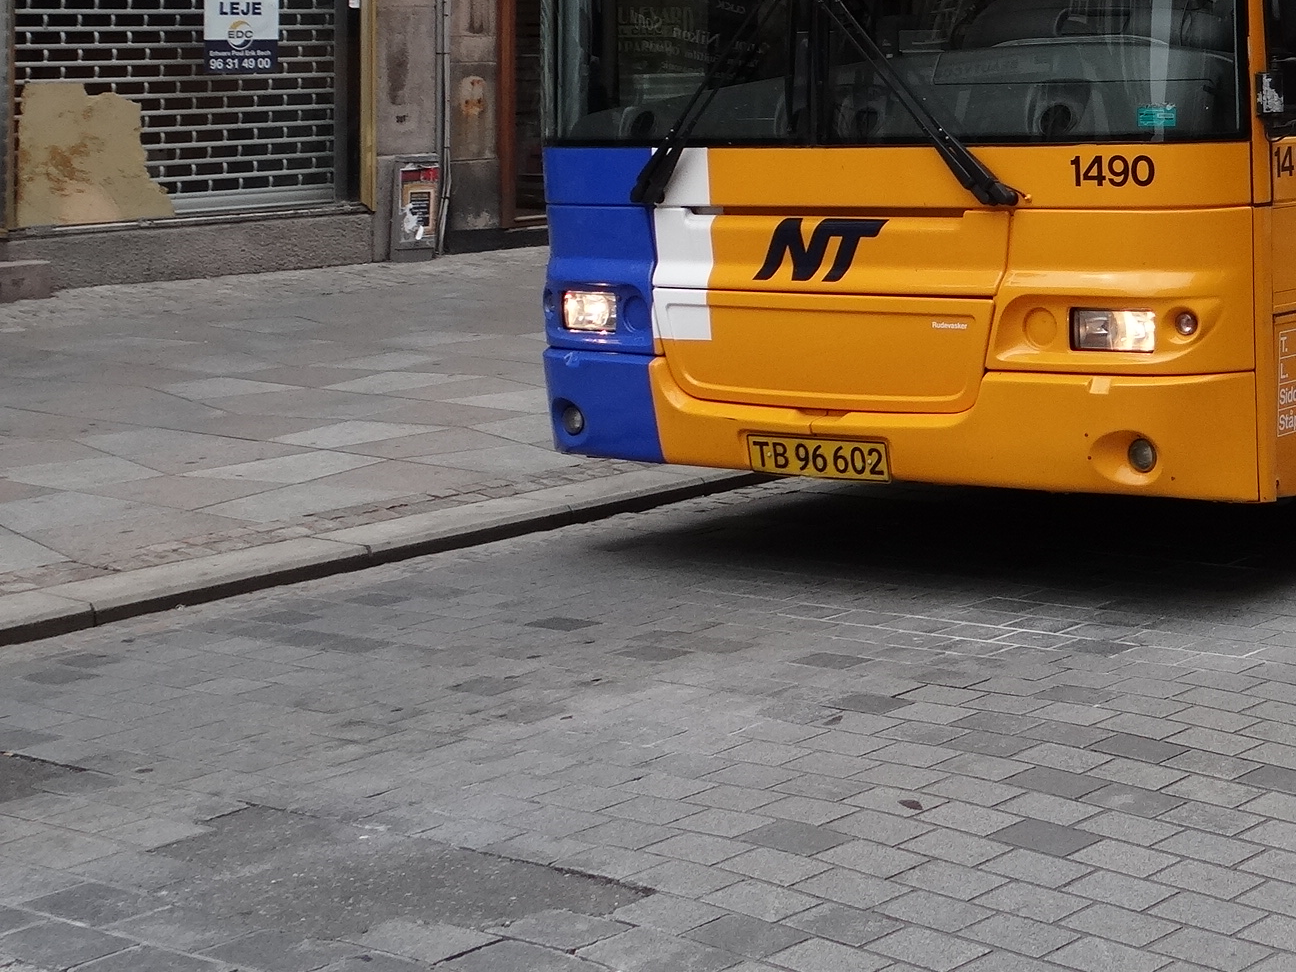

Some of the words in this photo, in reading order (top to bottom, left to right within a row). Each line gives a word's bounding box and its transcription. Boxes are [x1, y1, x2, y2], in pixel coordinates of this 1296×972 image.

[219, 1, 262, 16] LEJE
[227, 30, 254, 39] EDC
[209, 58, 224, 69] 96
[225, 58, 239, 69] 31
[241, 58, 256, 69] 49
[257, 58, 272, 69] 00
[1070, 154, 1156, 188] 1490
[752, 217, 890, 283] NT
[1280, 336, 1288, 353] T.
[1280, 362, 1289, 379] L.
[752, 440, 790, 469] TB
[794, 442, 828, 473] 96
[832, 445, 885, 476] 602
